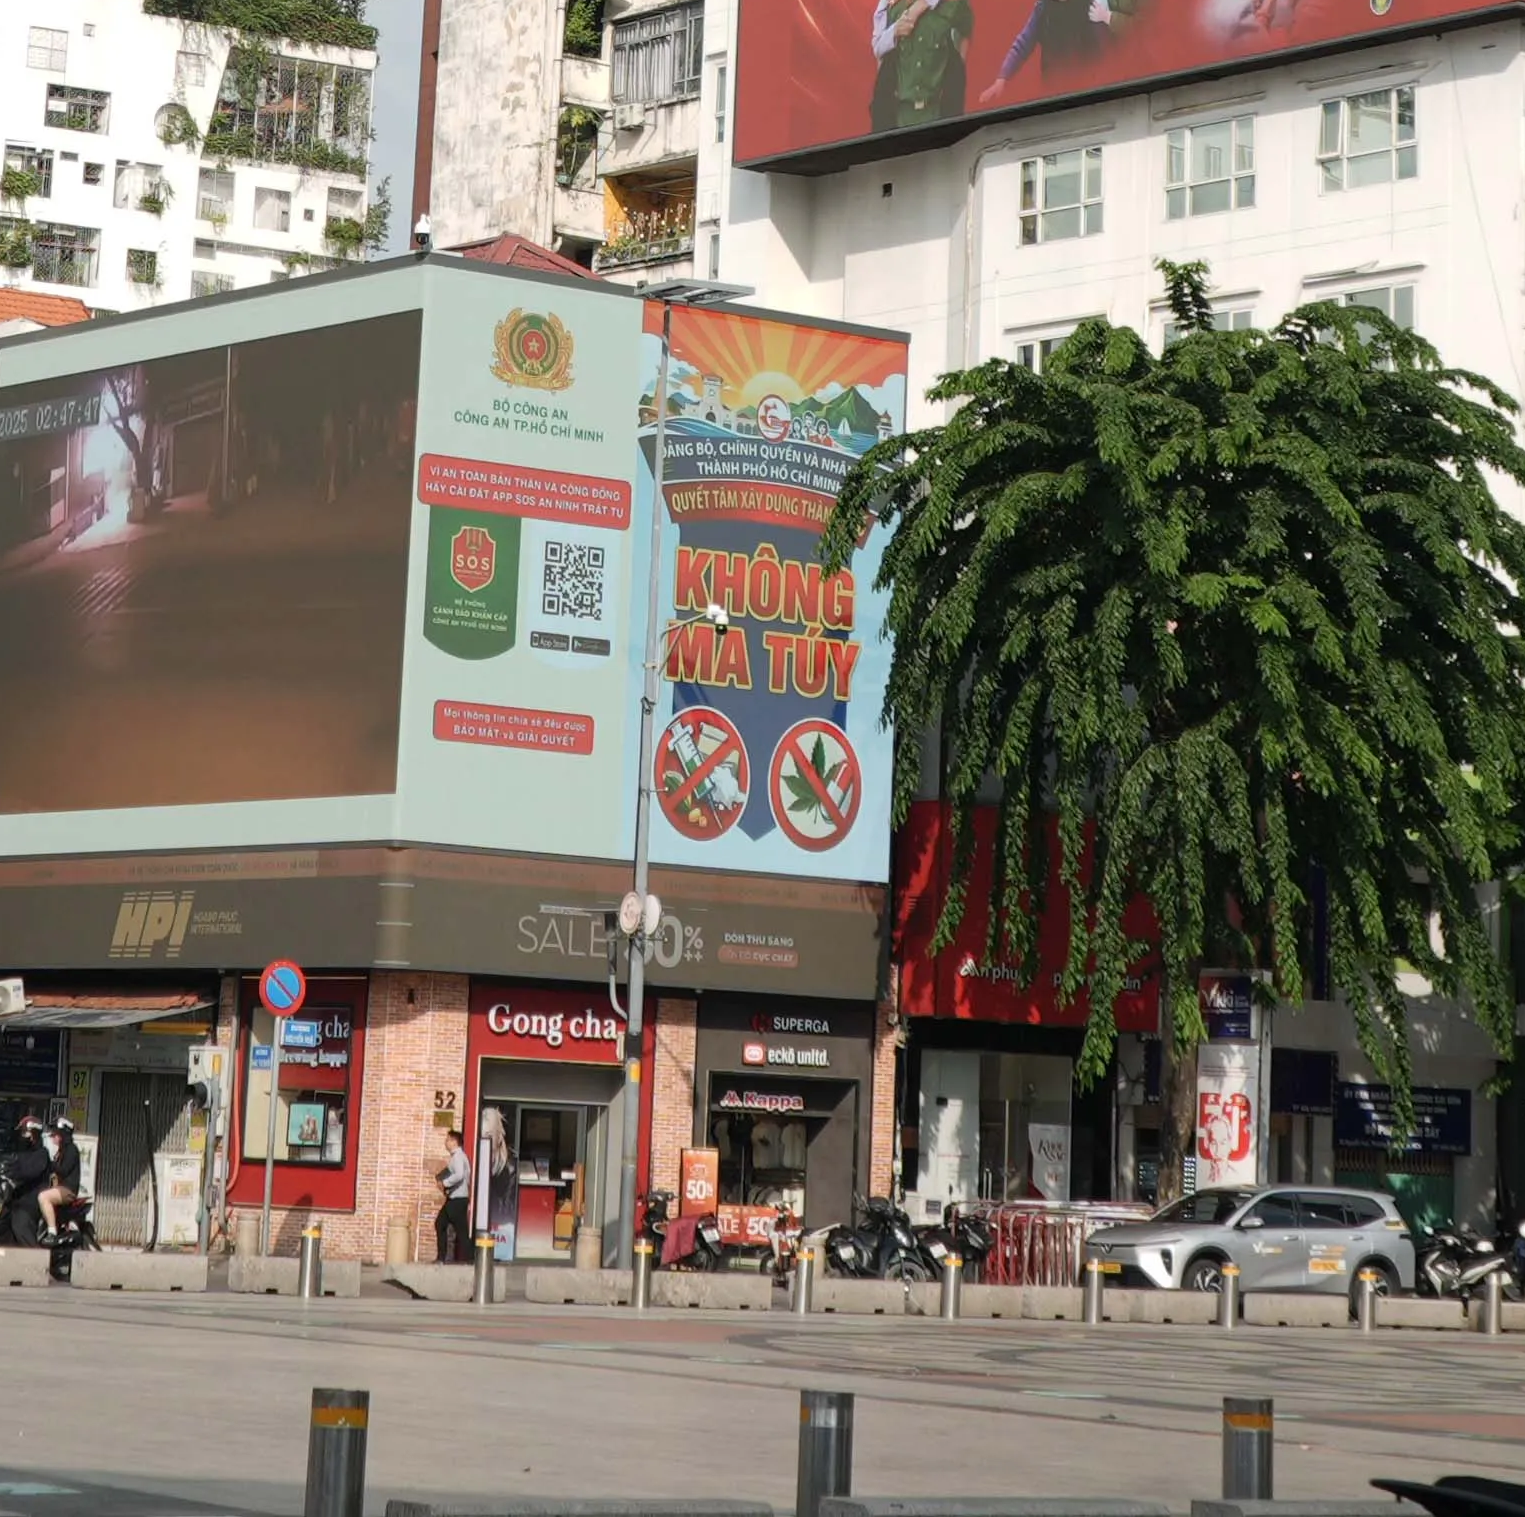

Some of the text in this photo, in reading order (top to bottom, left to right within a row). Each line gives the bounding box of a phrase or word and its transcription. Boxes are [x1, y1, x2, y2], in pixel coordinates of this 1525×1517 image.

[36, 397, 101, 431] 02:47:47
[493, 397, 569, 421] BỘ CÔNG AN
[454, 409, 605, 443] CÔNG AN CHÍ MINH
[719, 440, 819, 469] CHÍNH QUYỀN VÀ
[442, 467, 457, 479] AN
[696, 458, 812, 487] THÀNH PHỐ CHÍ
[492, 490, 580, 513] APP SOS AN NINH
[672, 483, 799, 518] QUYẾT TÂM XÂY DỰNG
[456, 553, 491, 571] SOS
[674, 542, 855, 631] KHÔNG
[665, 620, 862, 702] MA TÚY
[517, 915, 607, 959] SALE
[488, 1004, 617, 1046] Gong cha
[774, 1016, 830, 1033] SUPERGA
[434, 1090, 456, 1110] 52
[745, 1091, 804, 1112] Kappa
